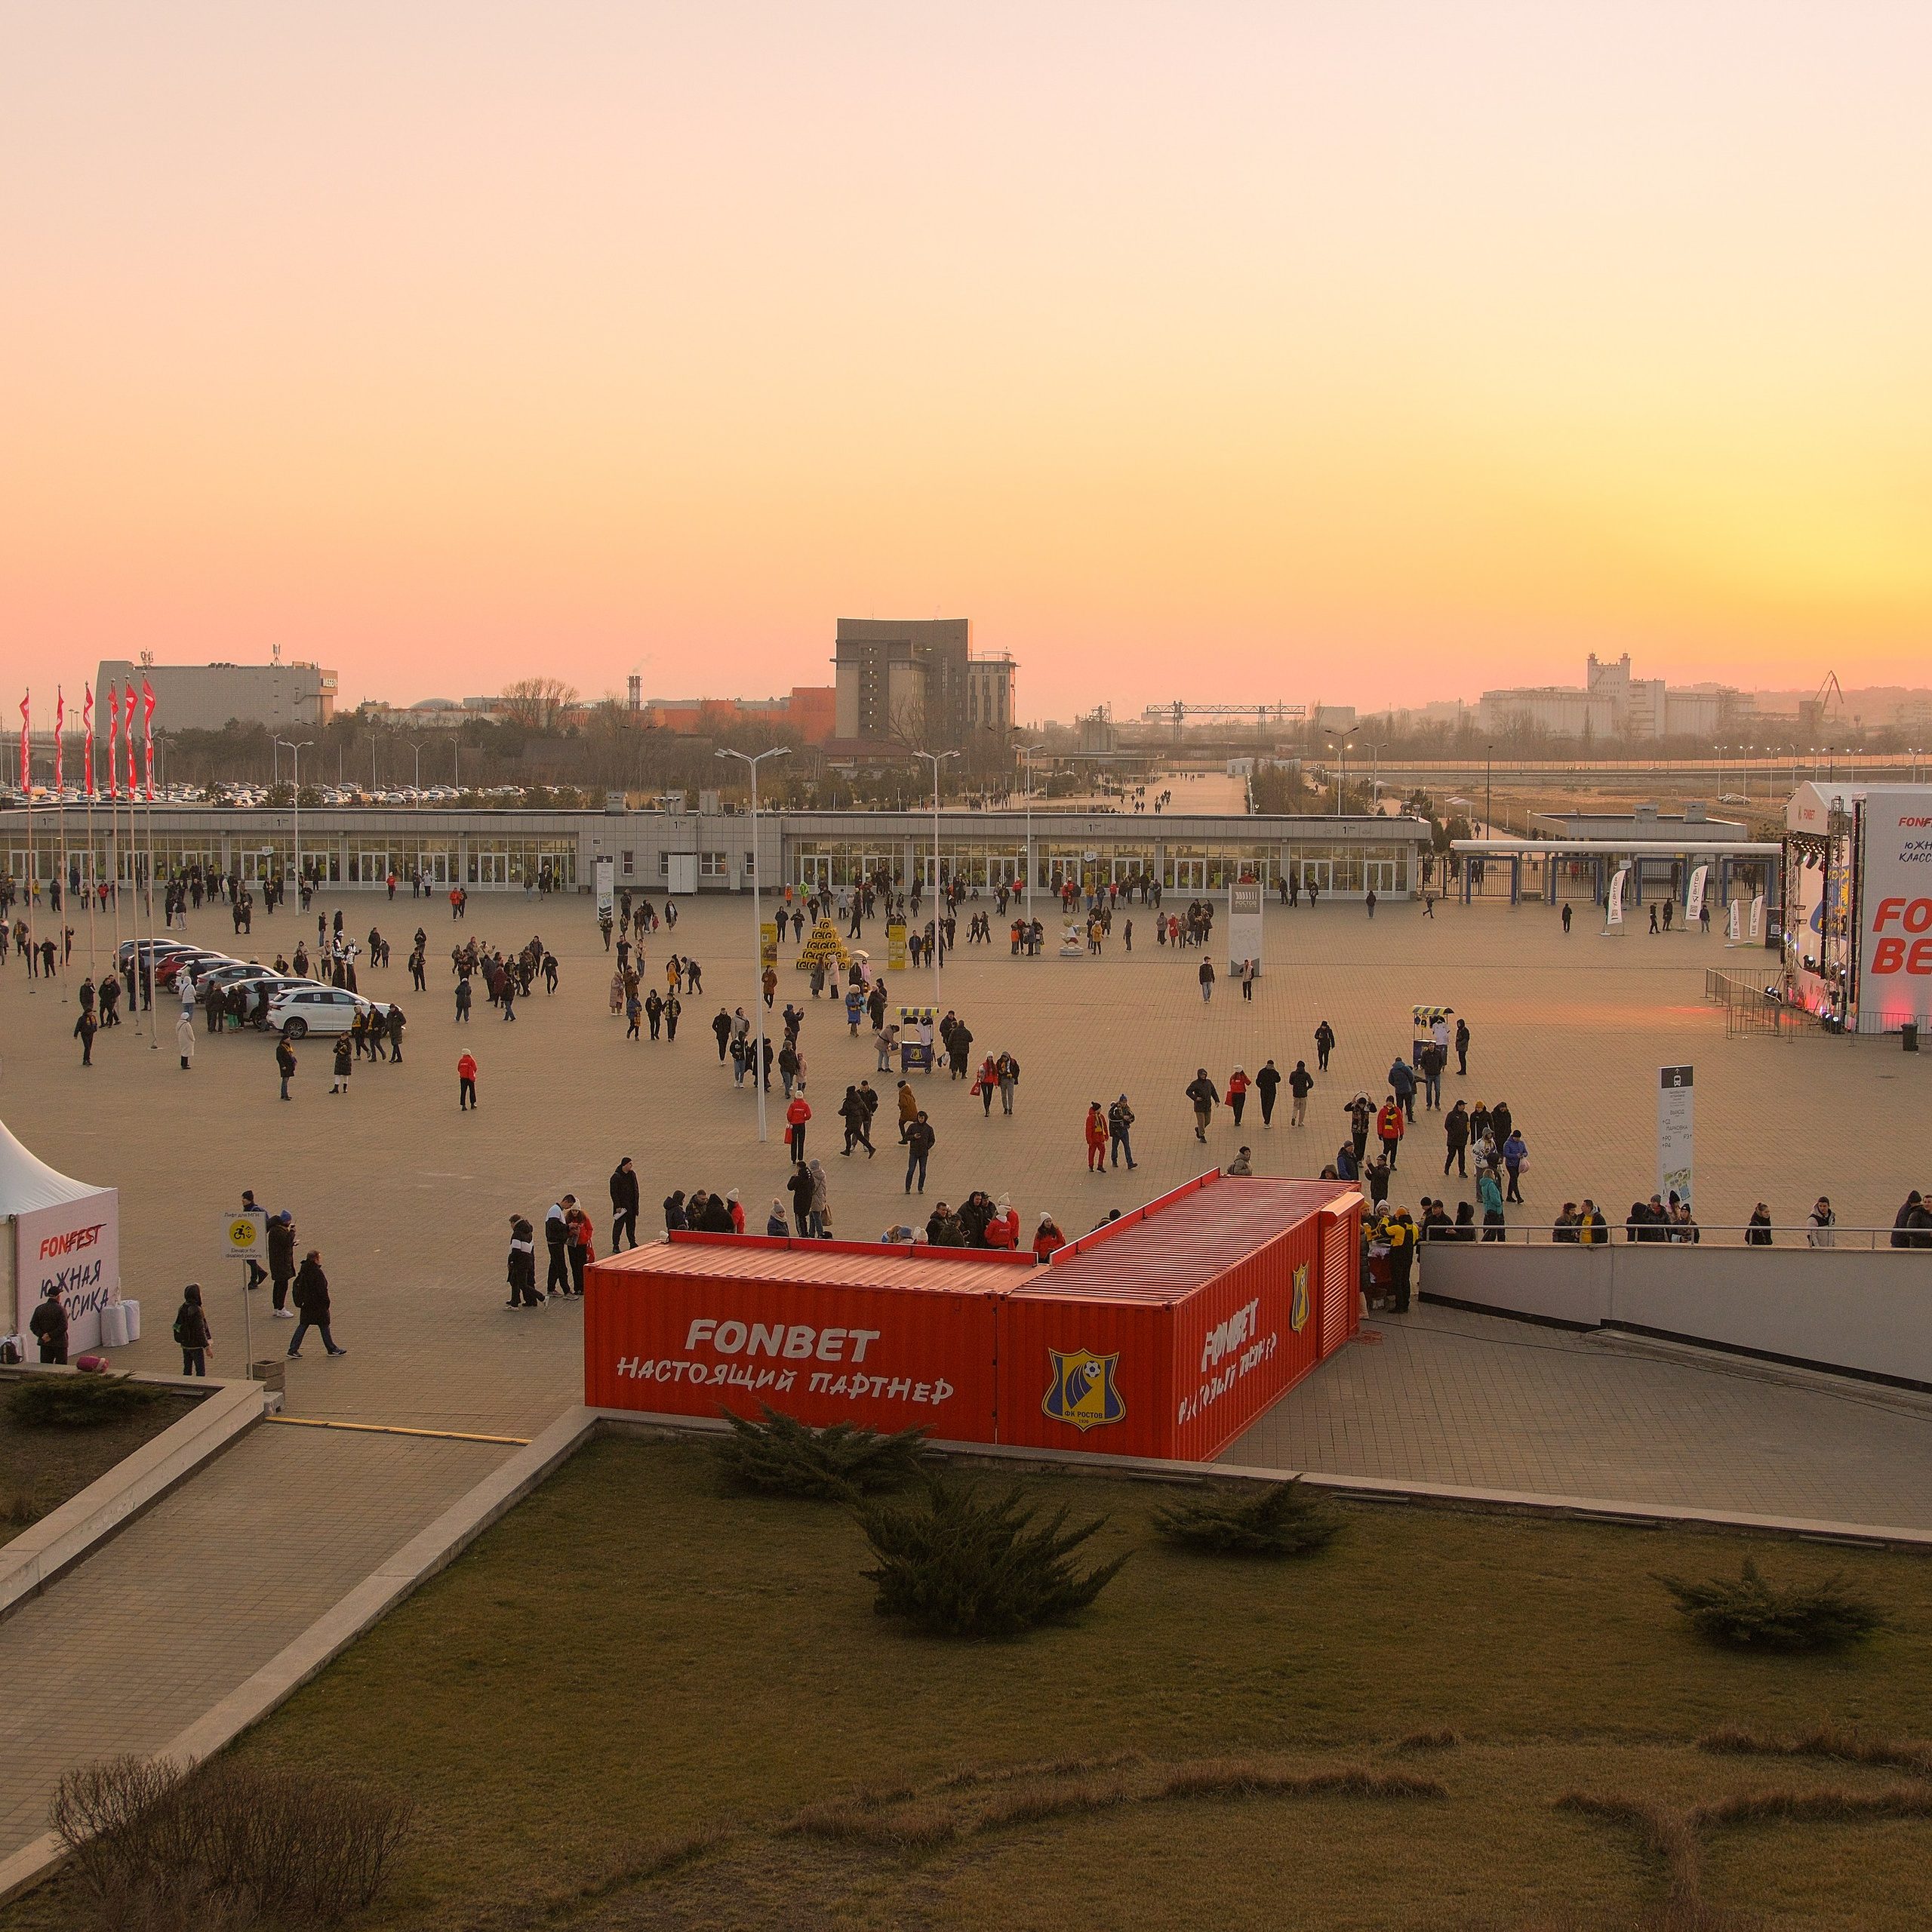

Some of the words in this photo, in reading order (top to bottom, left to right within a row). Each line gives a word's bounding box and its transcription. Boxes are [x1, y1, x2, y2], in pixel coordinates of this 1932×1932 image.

[276, 819, 281, 827] 1
[674, 821, 678, 829] 1
[1898, 817, 1932, 828] FONF
[1899, 852, 1932, 863] КЛАСС
[39, 1225, 103, 1260] FONFEST
[40, 1260, 101, 1299] ЮЖНАЯ
[685, 1318, 880, 1363] FONBET
[617, 1356, 798, 1392] НАСТОЯЩИЙ
[808, 1371, 954, 1405] ПАРТНЕР
